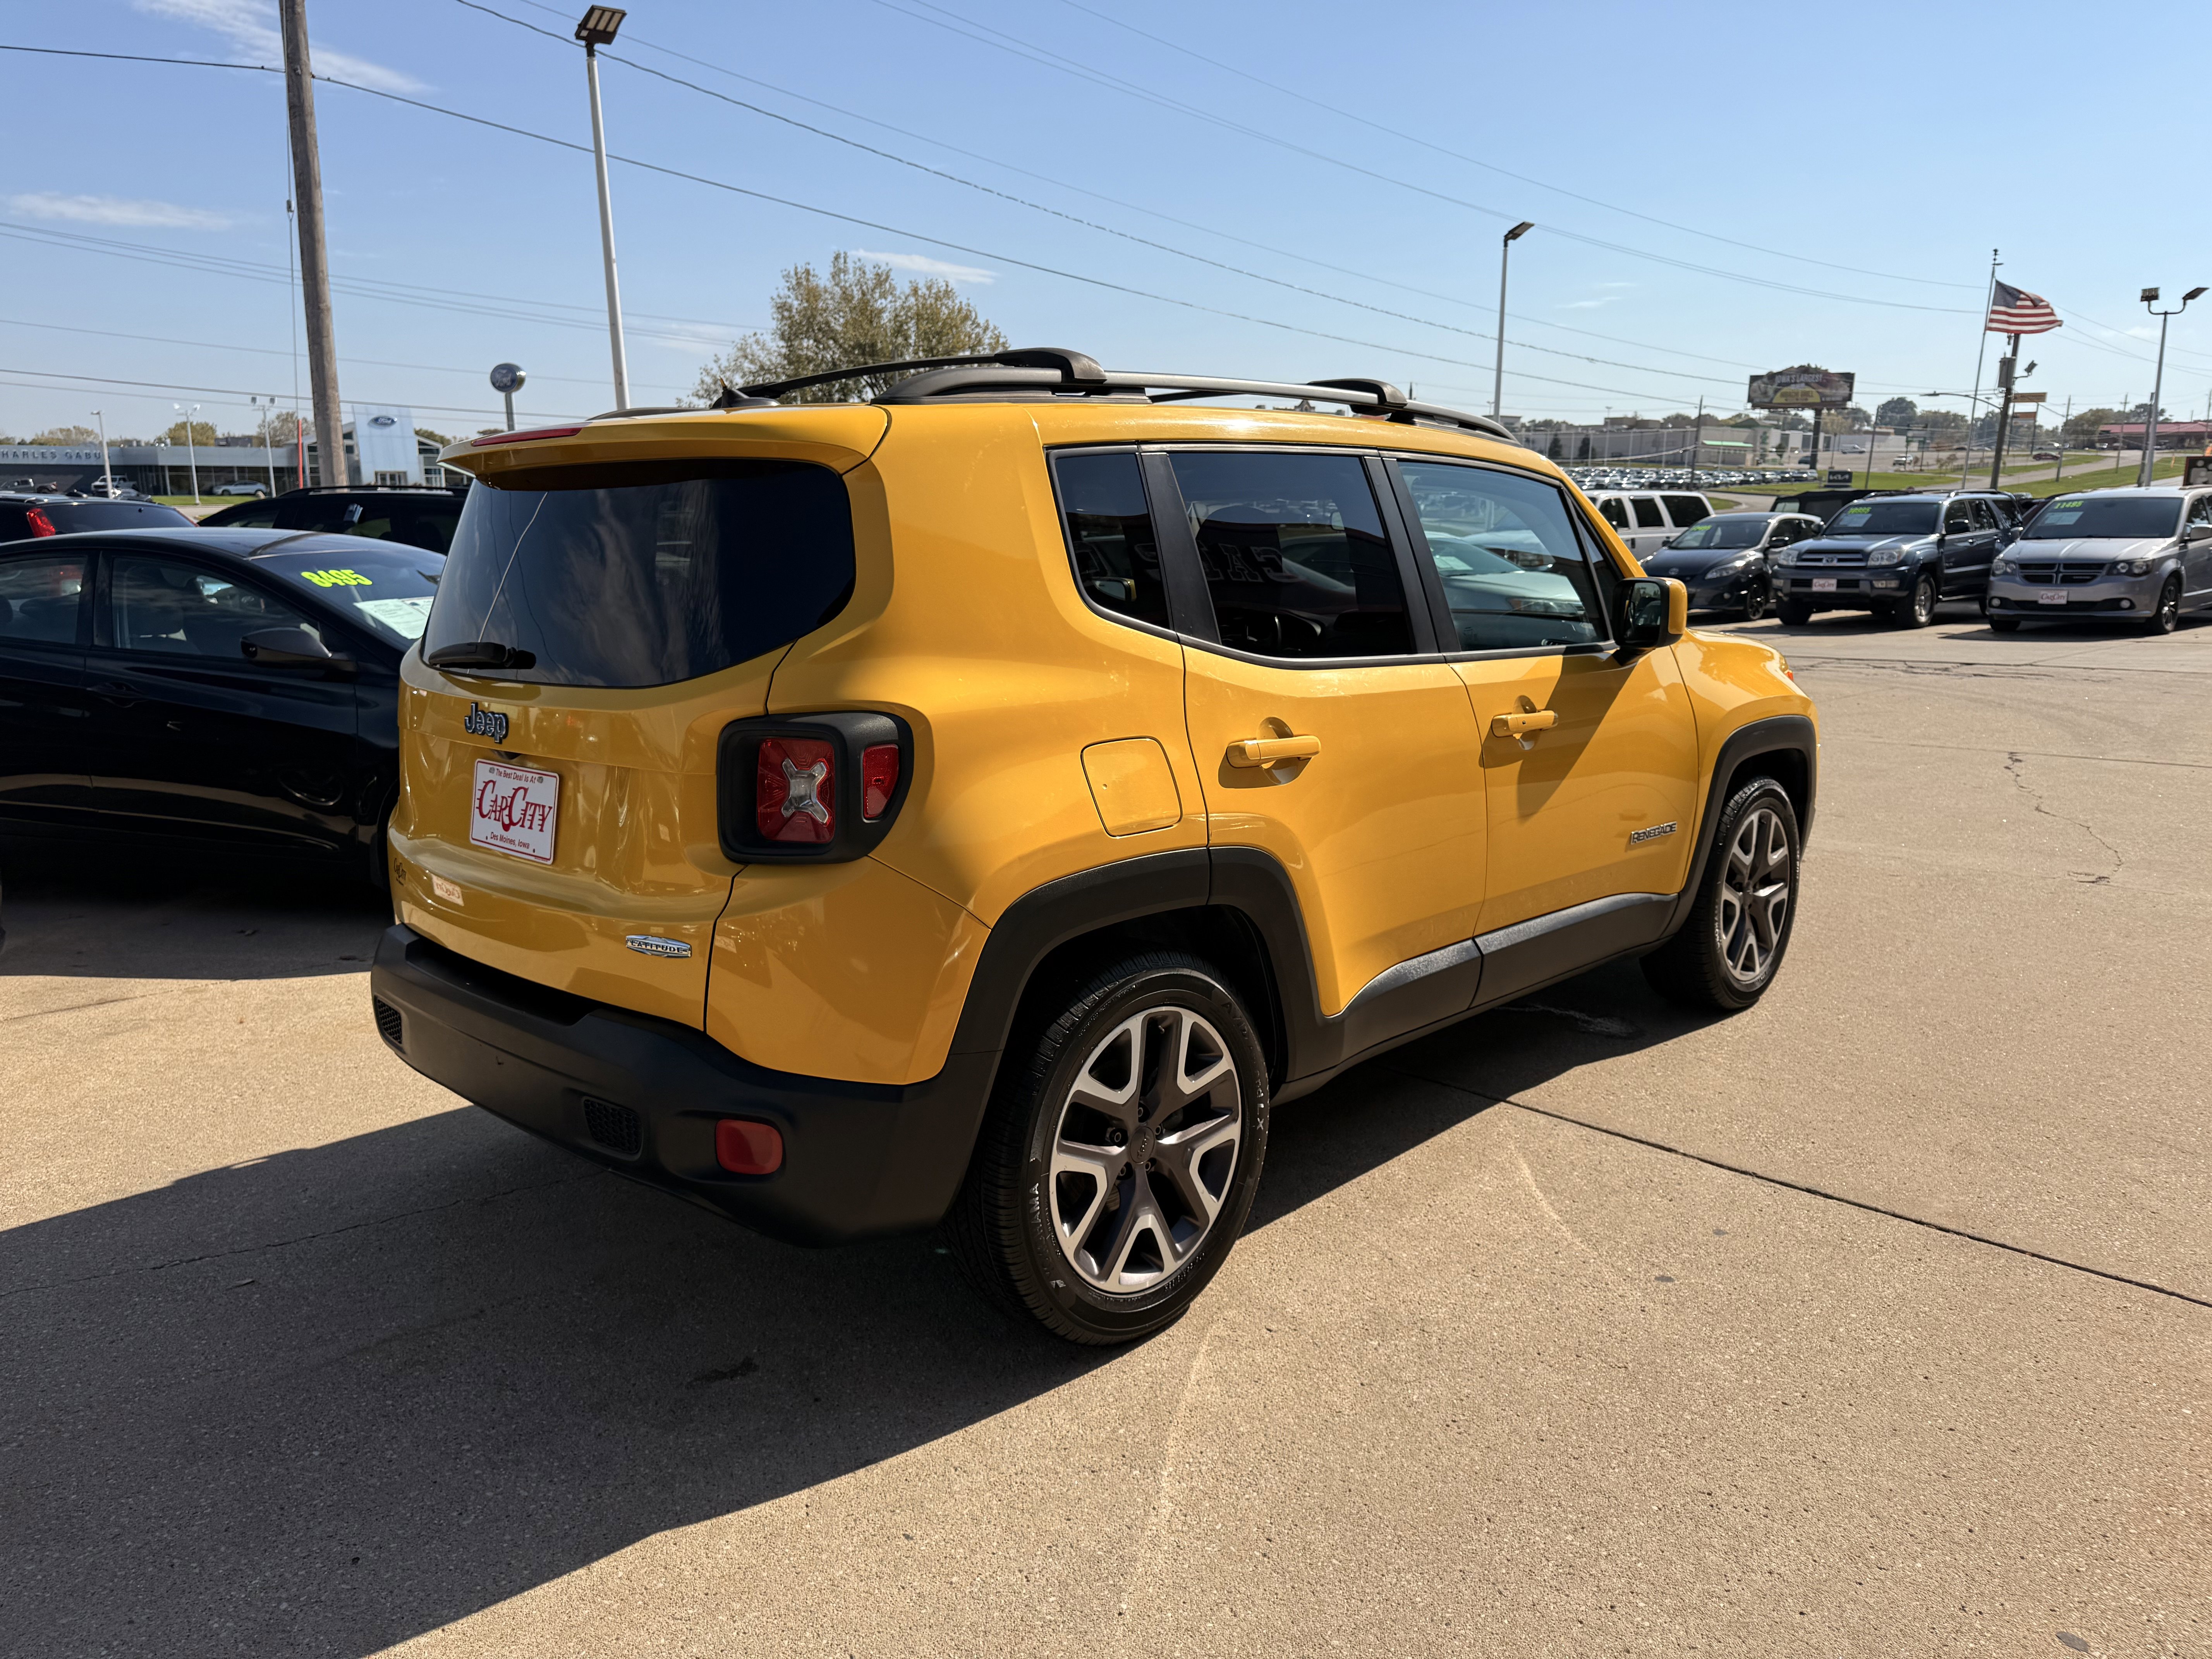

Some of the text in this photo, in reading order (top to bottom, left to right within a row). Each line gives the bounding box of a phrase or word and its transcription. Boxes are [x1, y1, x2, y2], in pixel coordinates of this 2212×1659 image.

[65, 450, 110, 460] GABU
[301, 569, 373, 587] 8495
[465, 702, 509, 744] Jeep
[503, 770, 513, 779] Best
[513, 772, 524, 781] Deal
[524, 774, 529, 782] Is
[1631, 821, 1677, 845] RENEGADE
[499, 834, 517, 847] Moines,
[518, 839, 530, 849] Iowa
[631, 940, 684, 953] LATITUDE
[1257, 1103, 1264, 1130] LX
